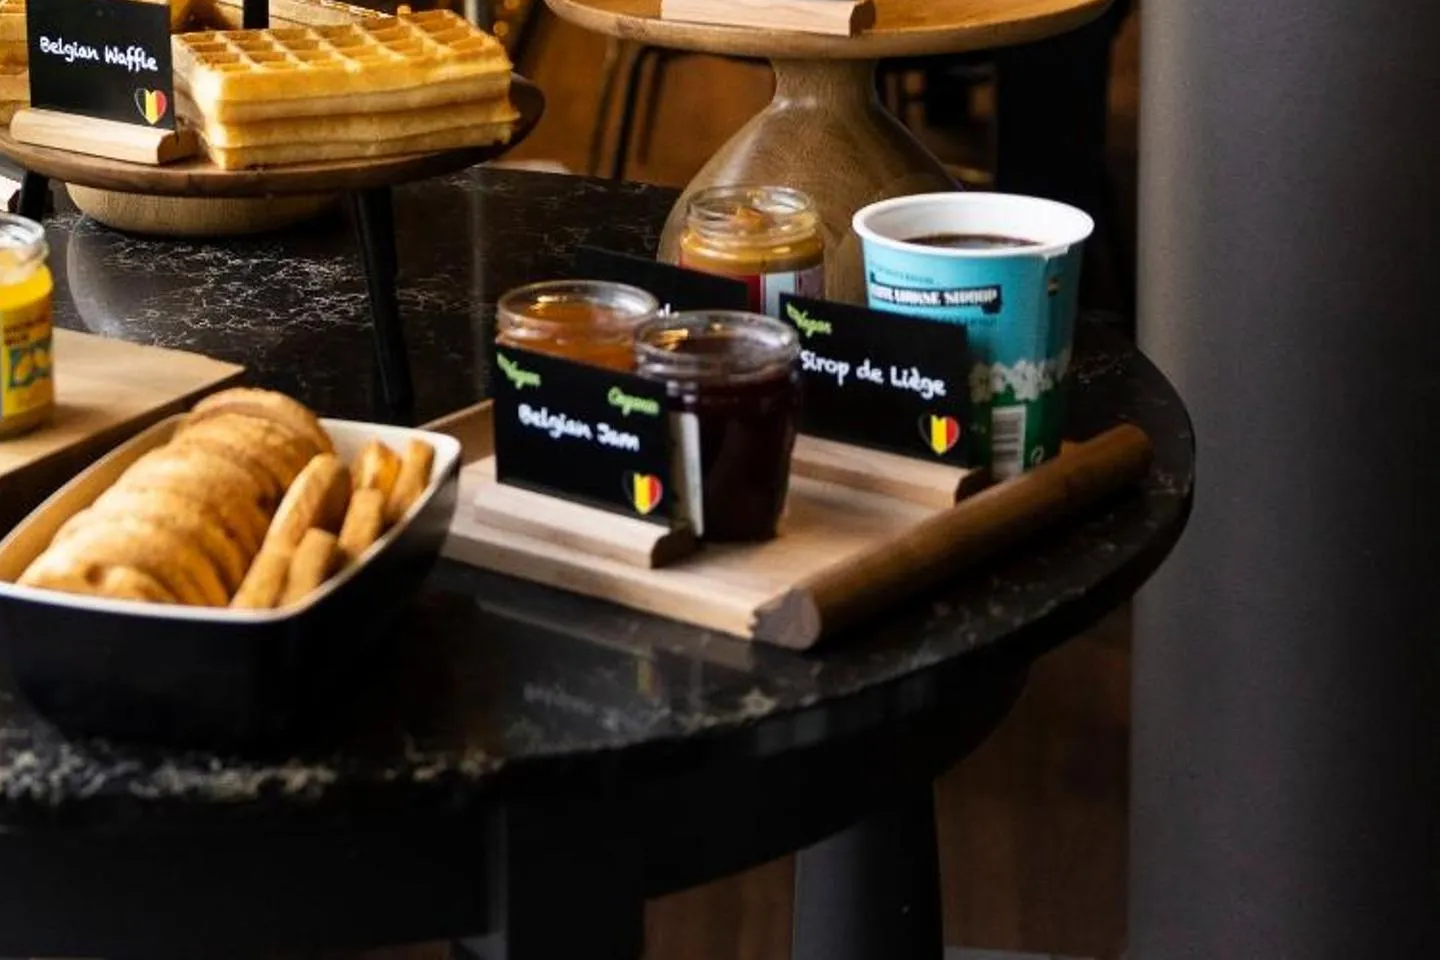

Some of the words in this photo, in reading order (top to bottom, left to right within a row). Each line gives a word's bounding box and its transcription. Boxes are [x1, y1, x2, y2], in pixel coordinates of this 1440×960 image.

[39, 36, 100, 63] Belgian
[104, 44, 159, 72] Waffle
[800, 349, 850, 387] Sirop
[856, 358, 884, 384] de
[890, 365, 947, 400] Liège
[518, 403, 593, 440] Belgian
[596, 422, 640, 452] Jam
